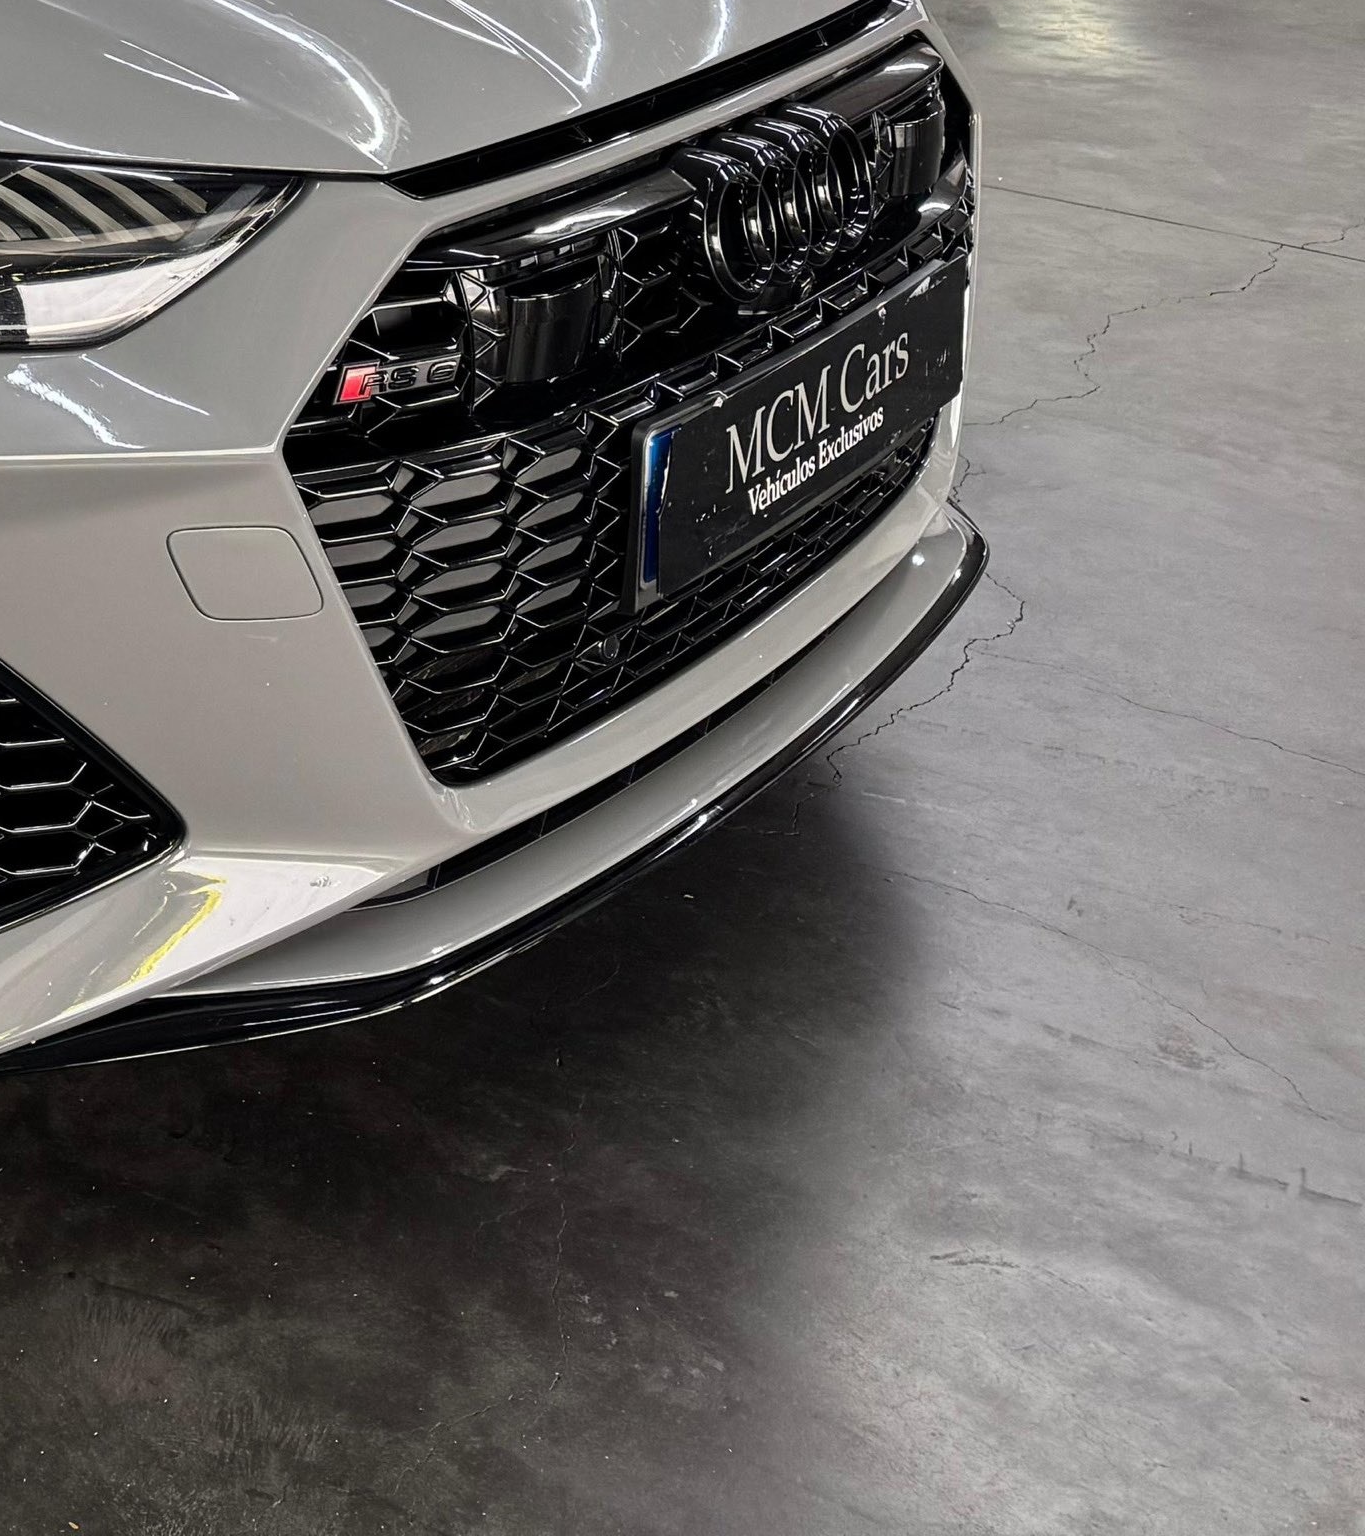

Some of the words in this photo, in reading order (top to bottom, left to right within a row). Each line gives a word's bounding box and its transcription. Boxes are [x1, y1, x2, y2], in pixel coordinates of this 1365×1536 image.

[725, 364, 832, 494] MCM
[840, 332, 910, 414] Cars
[747, 455, 816, 515] Vehículos
[818, 406, 884, 470] Exclusivos
